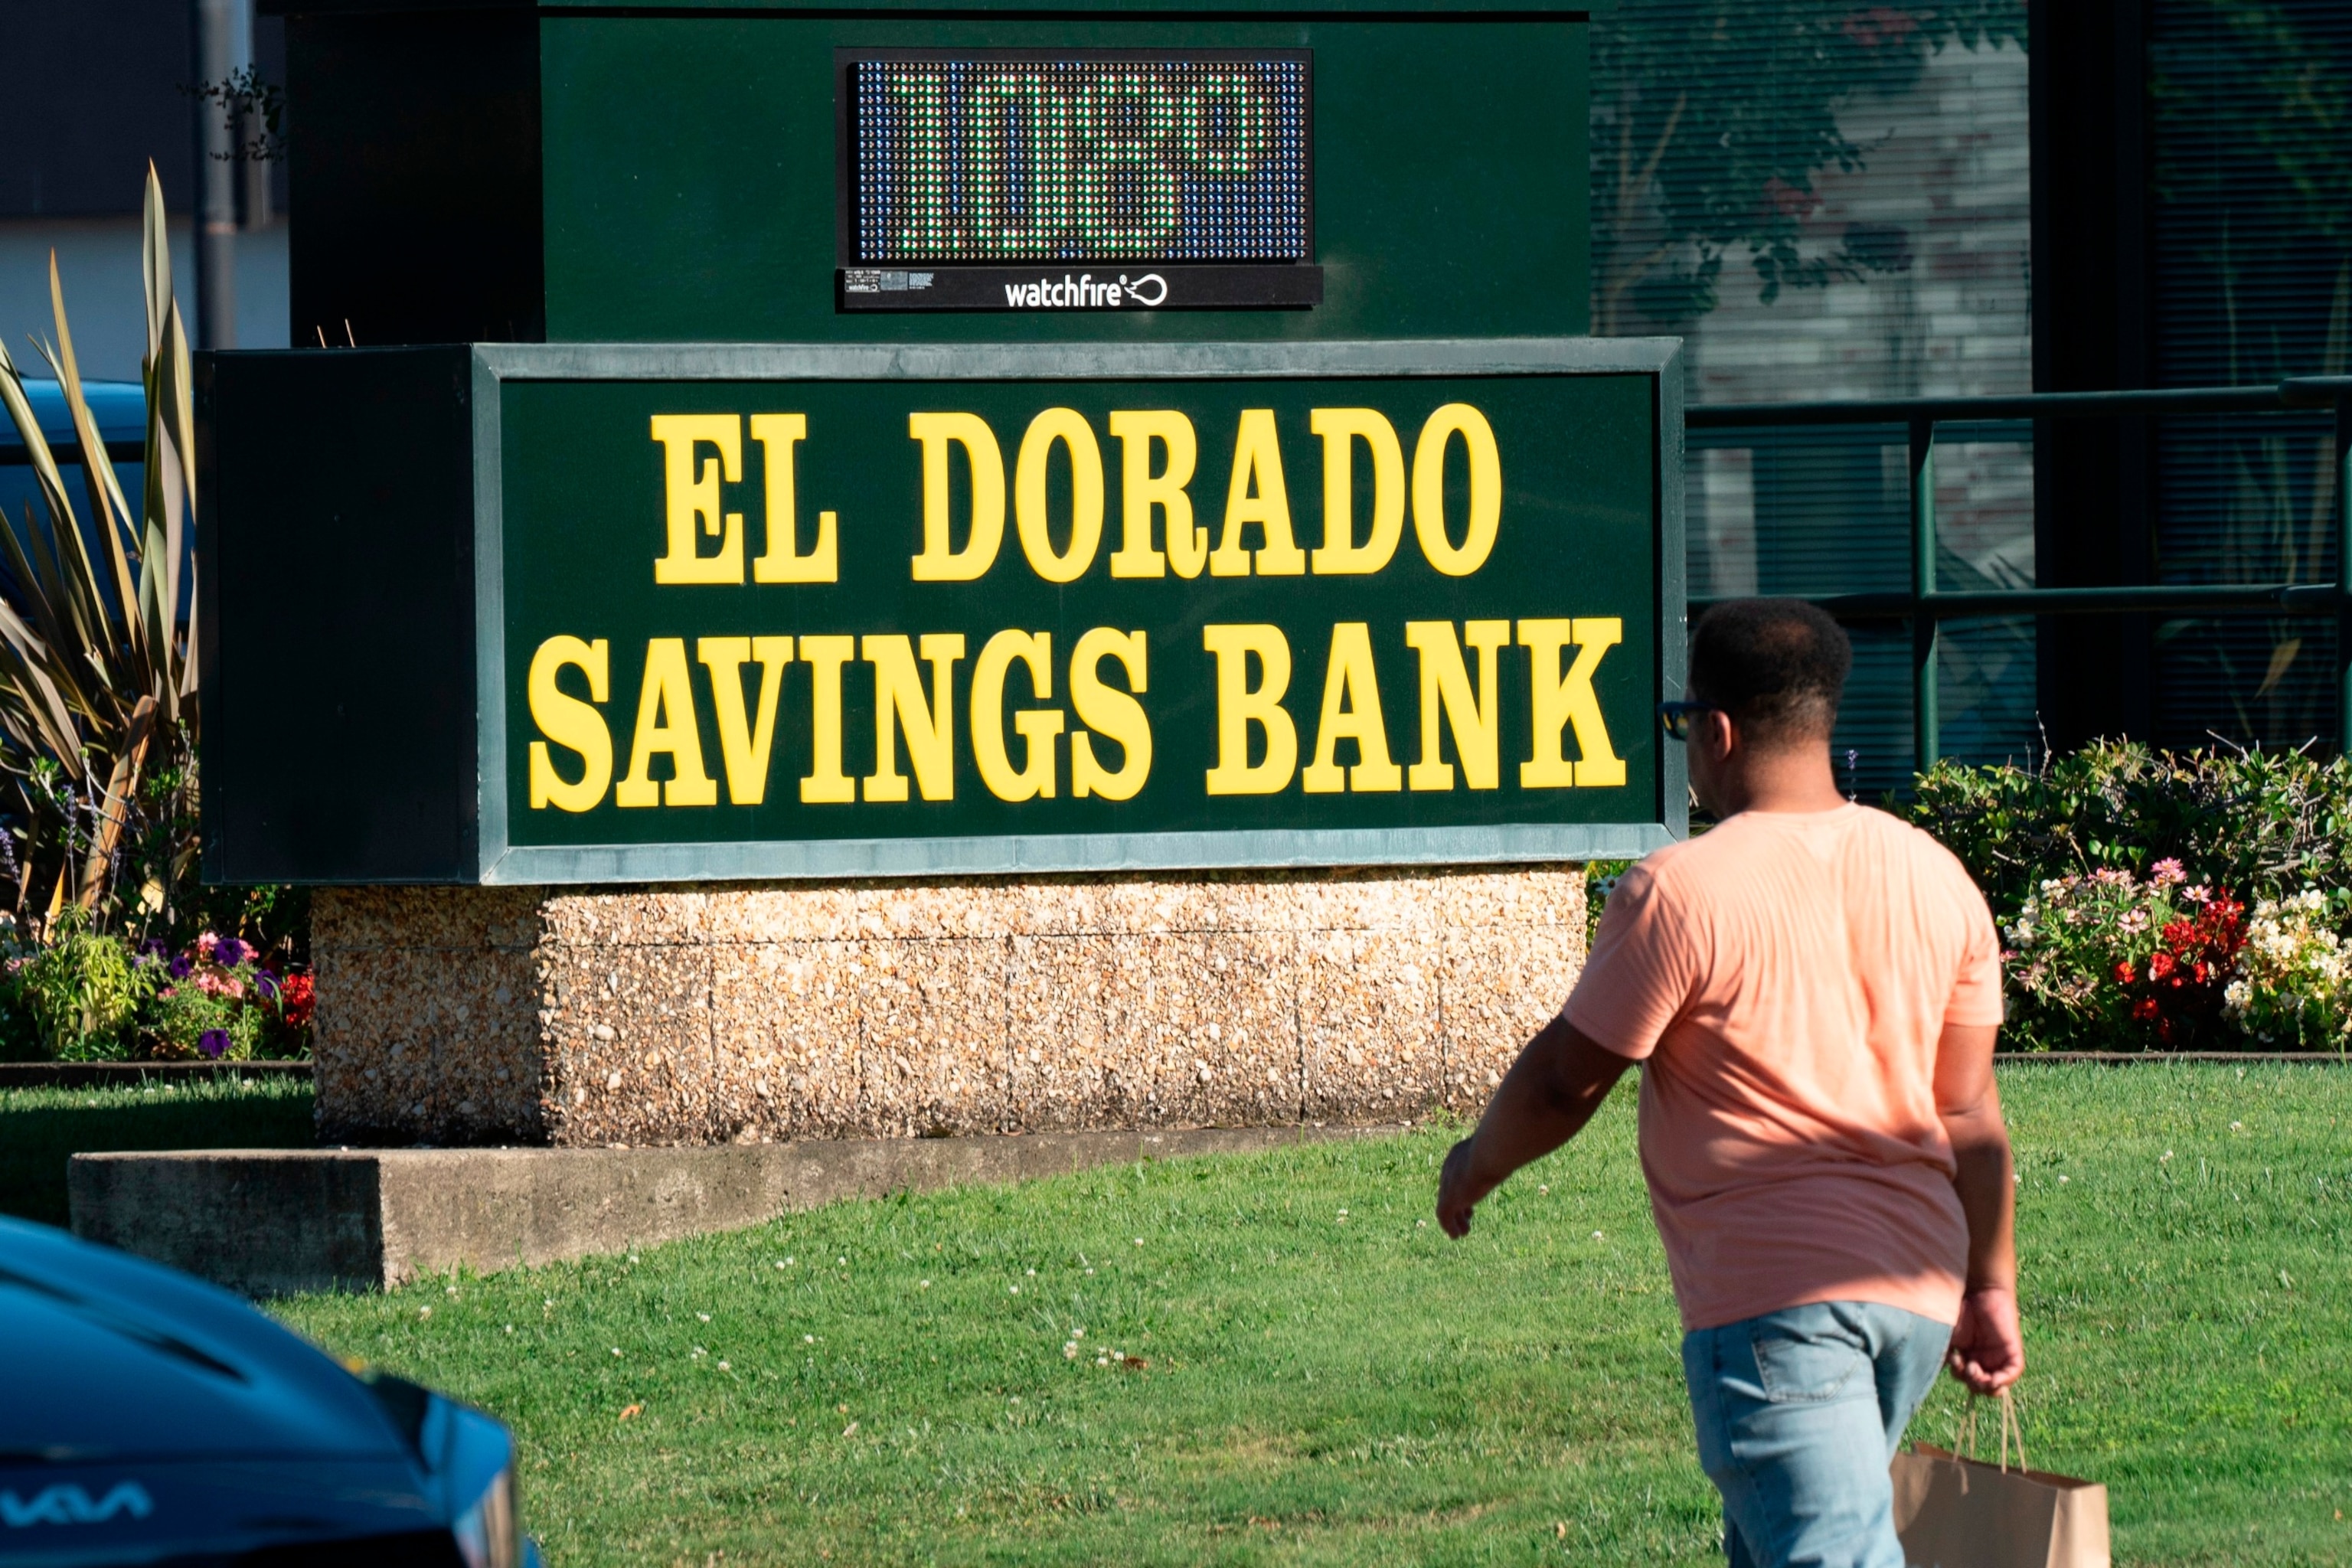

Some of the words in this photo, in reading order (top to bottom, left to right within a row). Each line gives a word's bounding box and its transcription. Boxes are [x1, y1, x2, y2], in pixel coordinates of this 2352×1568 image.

[651, 413, 838, 584] EL
[909, 403, 1501, 583] DORADO
[528, 627, 1152, 812] SAVINGS
[1204, 617, 1626, 795] BANK
